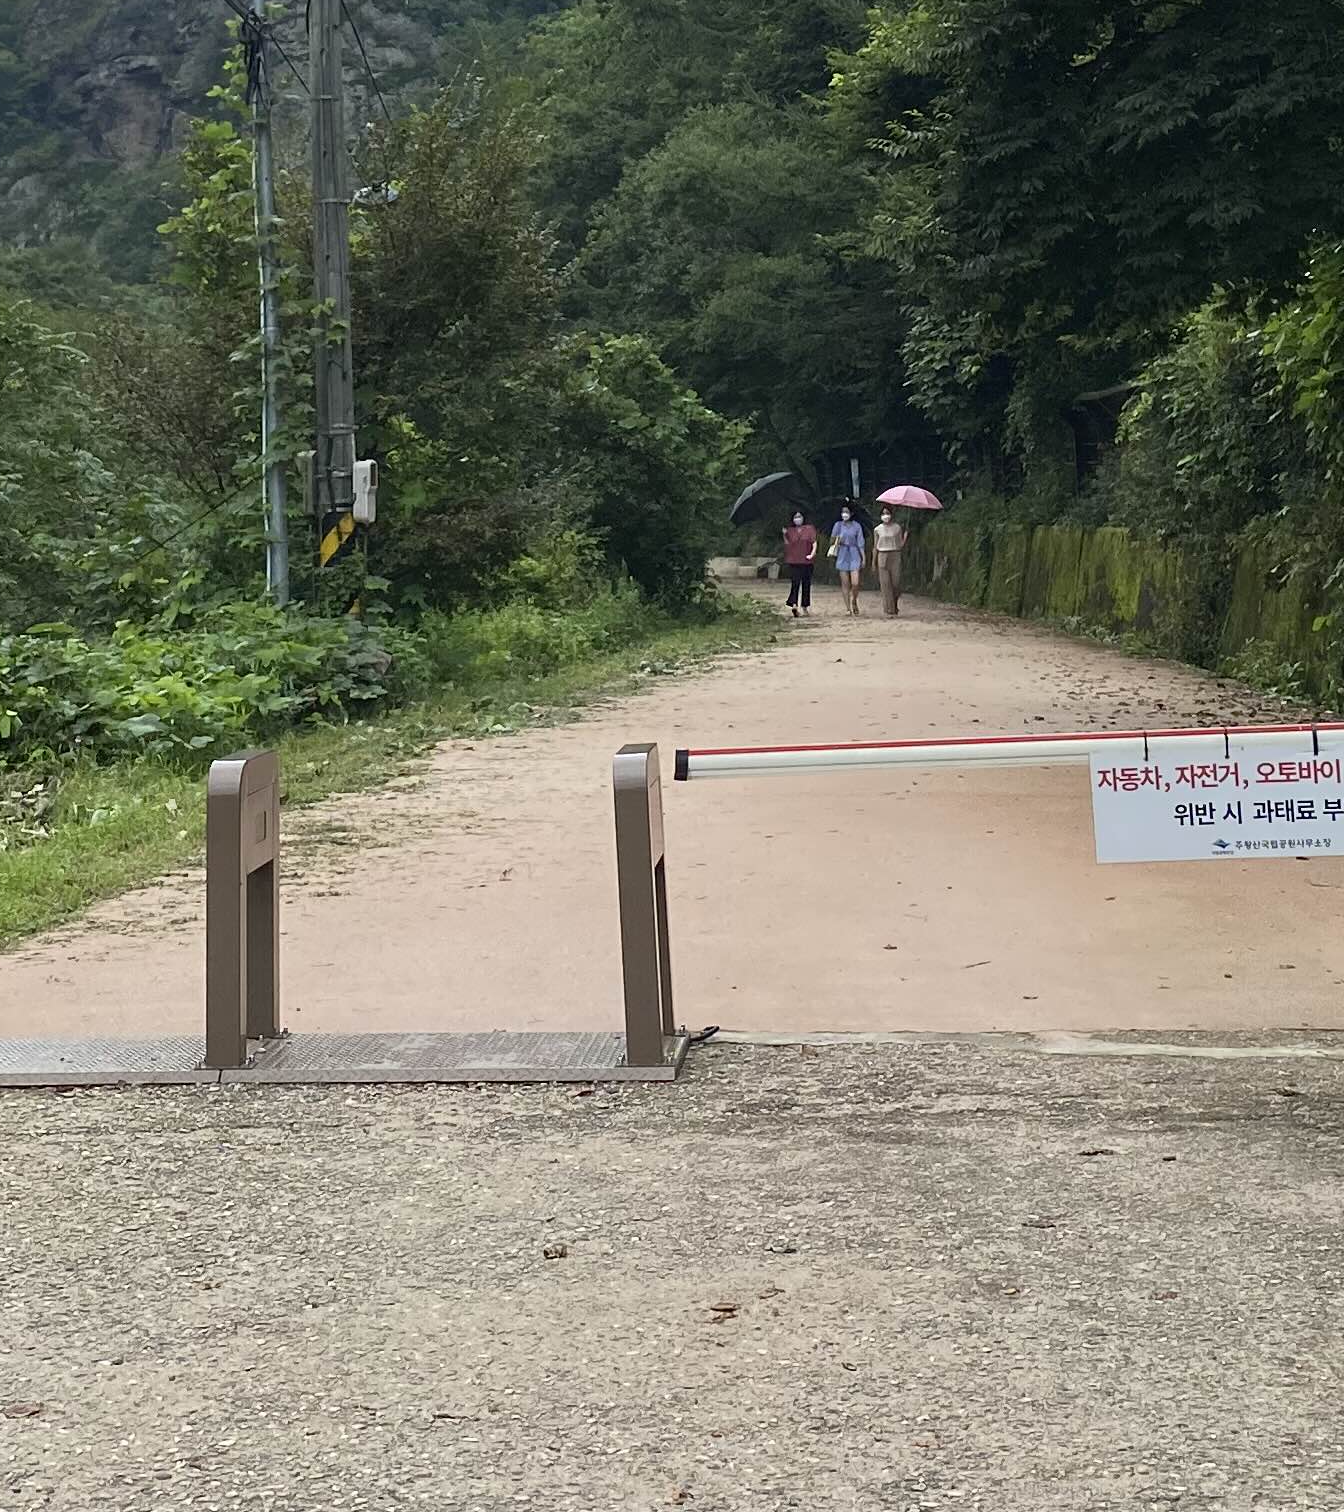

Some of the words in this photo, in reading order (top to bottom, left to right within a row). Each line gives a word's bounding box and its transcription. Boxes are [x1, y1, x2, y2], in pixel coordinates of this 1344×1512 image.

[1097, 765, 1171, 792] 자동차,
[1175, 762, 1249, 789] 자전거,
[1256, 759, 1342, 785] 오토바이
[1174, 802, 1215, 826] 위반
[1223, 800, 1243, 824] 시
[1253, 798, 1318, 823] 과태료
